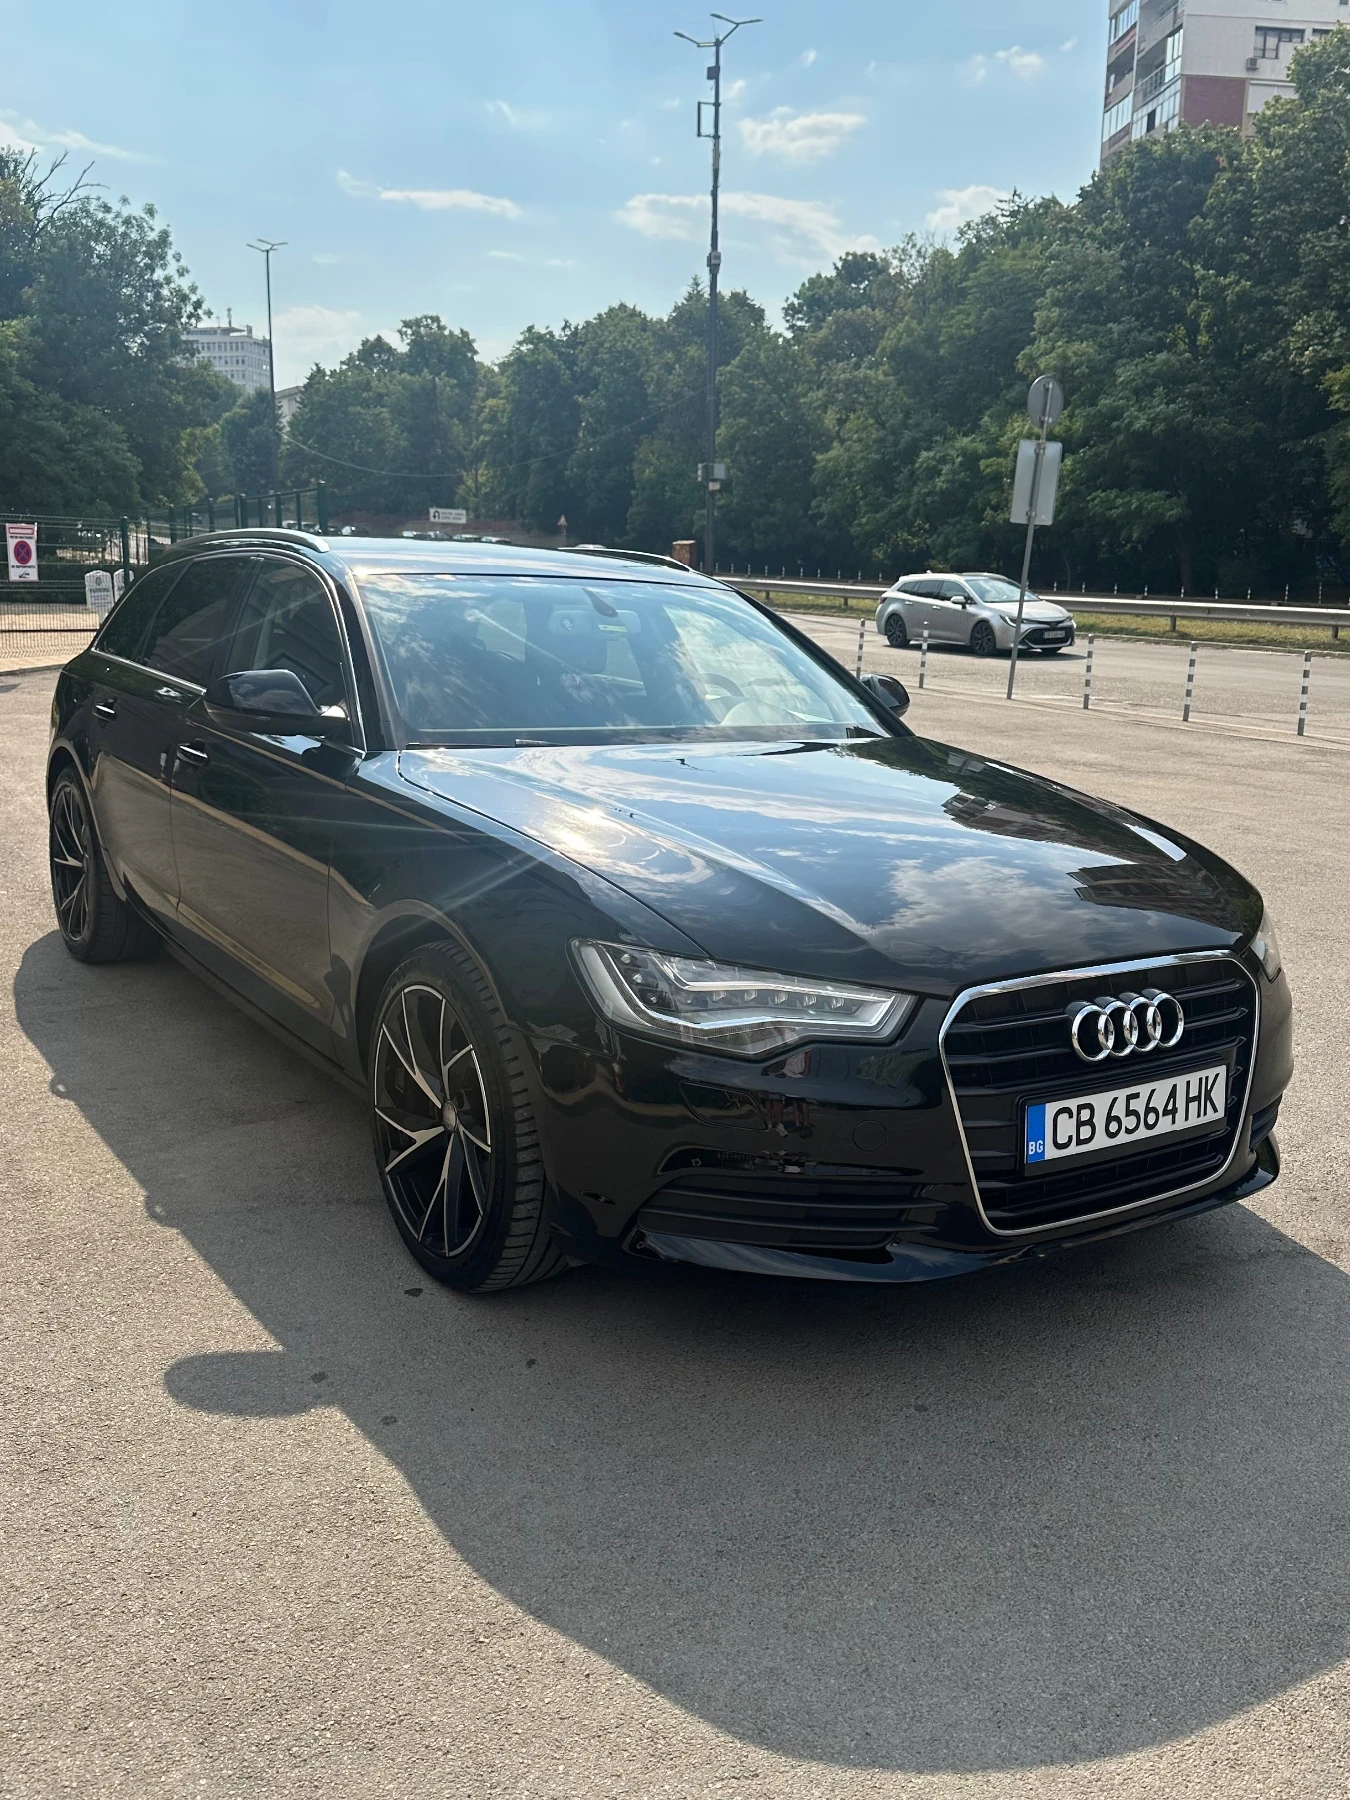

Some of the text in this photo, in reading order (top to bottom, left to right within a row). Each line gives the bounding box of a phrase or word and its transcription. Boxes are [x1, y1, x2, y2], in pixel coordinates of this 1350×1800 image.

[1052, 1072, 1220, 1150] CB 6564 HK
[1028, 1141, 1044, 1155] BG
